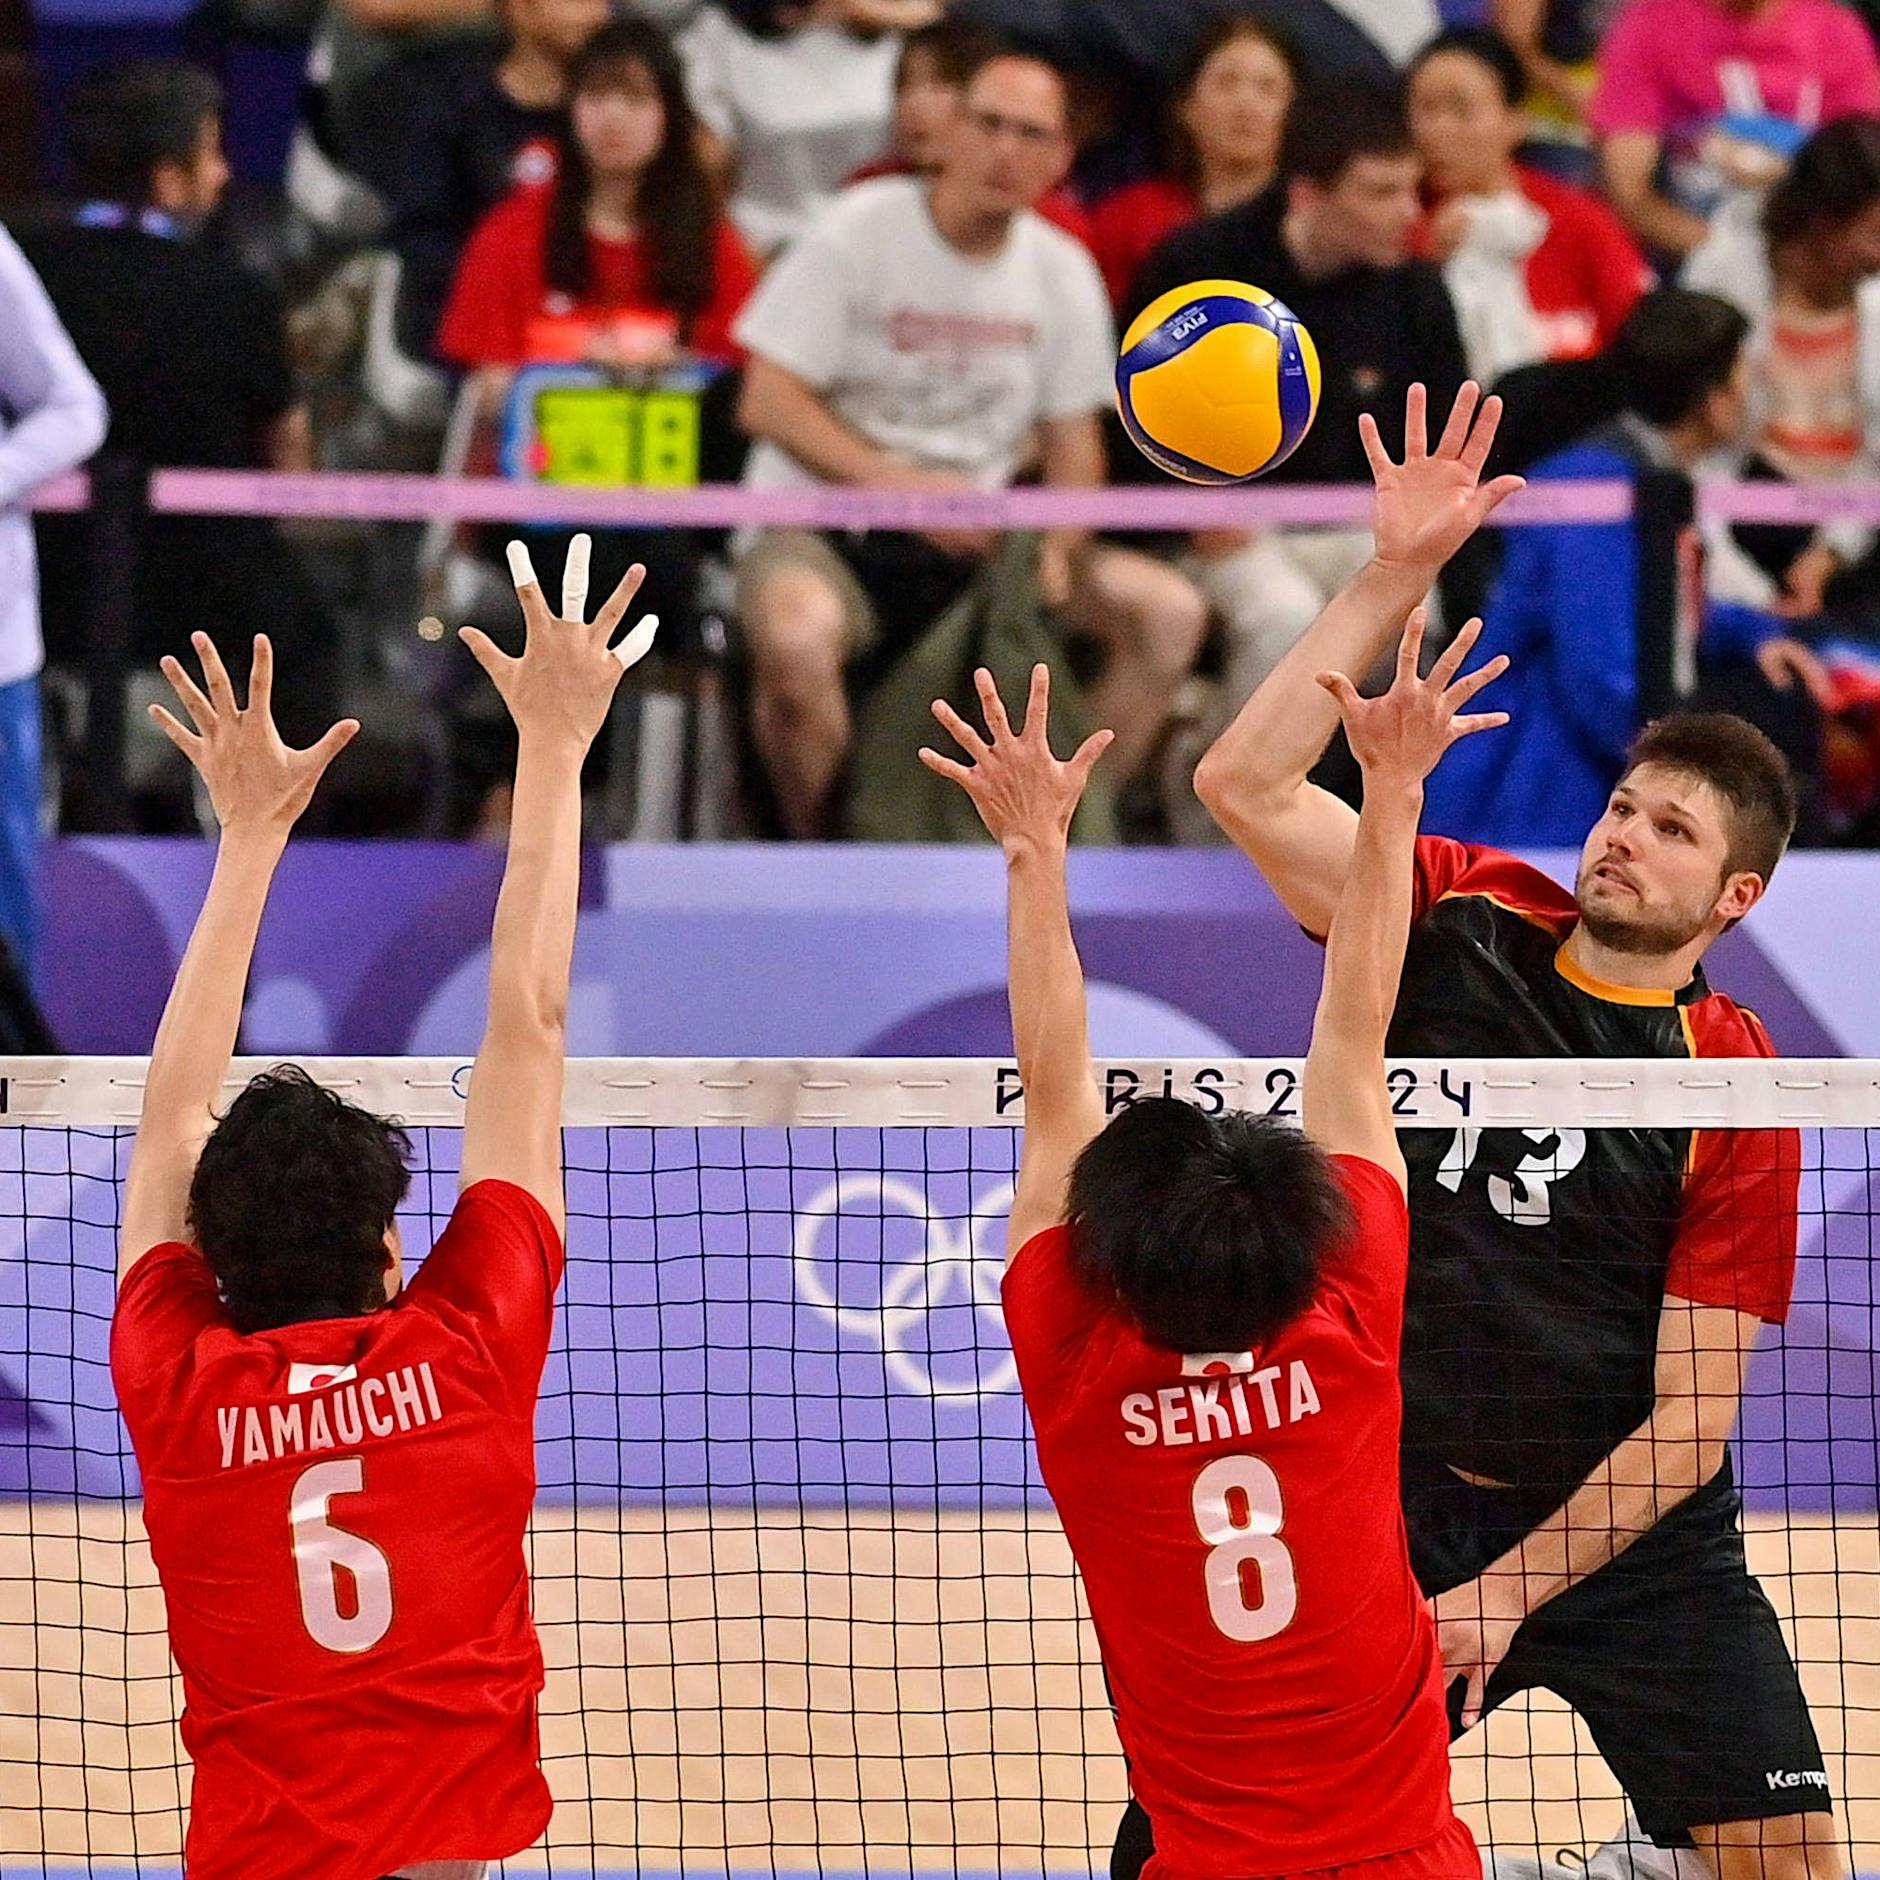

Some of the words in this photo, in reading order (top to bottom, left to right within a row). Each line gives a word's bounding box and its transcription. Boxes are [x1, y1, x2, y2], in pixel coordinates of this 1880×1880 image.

[1172, 312, 1208, 340] FIVB
[996, 1068, 1224, 1115] PRiS
[1265, 1068, 1471, 1117] 224
[217, 1361, 442, 1468] YAMAUCHI
[1120, 1360, 1321, 1446] SEKITA
[289, 1455, 394, 1654] 6
[1191, 1454, 1297, 1643] 8
[1765, 1769, 1828, 1790] Kemp
